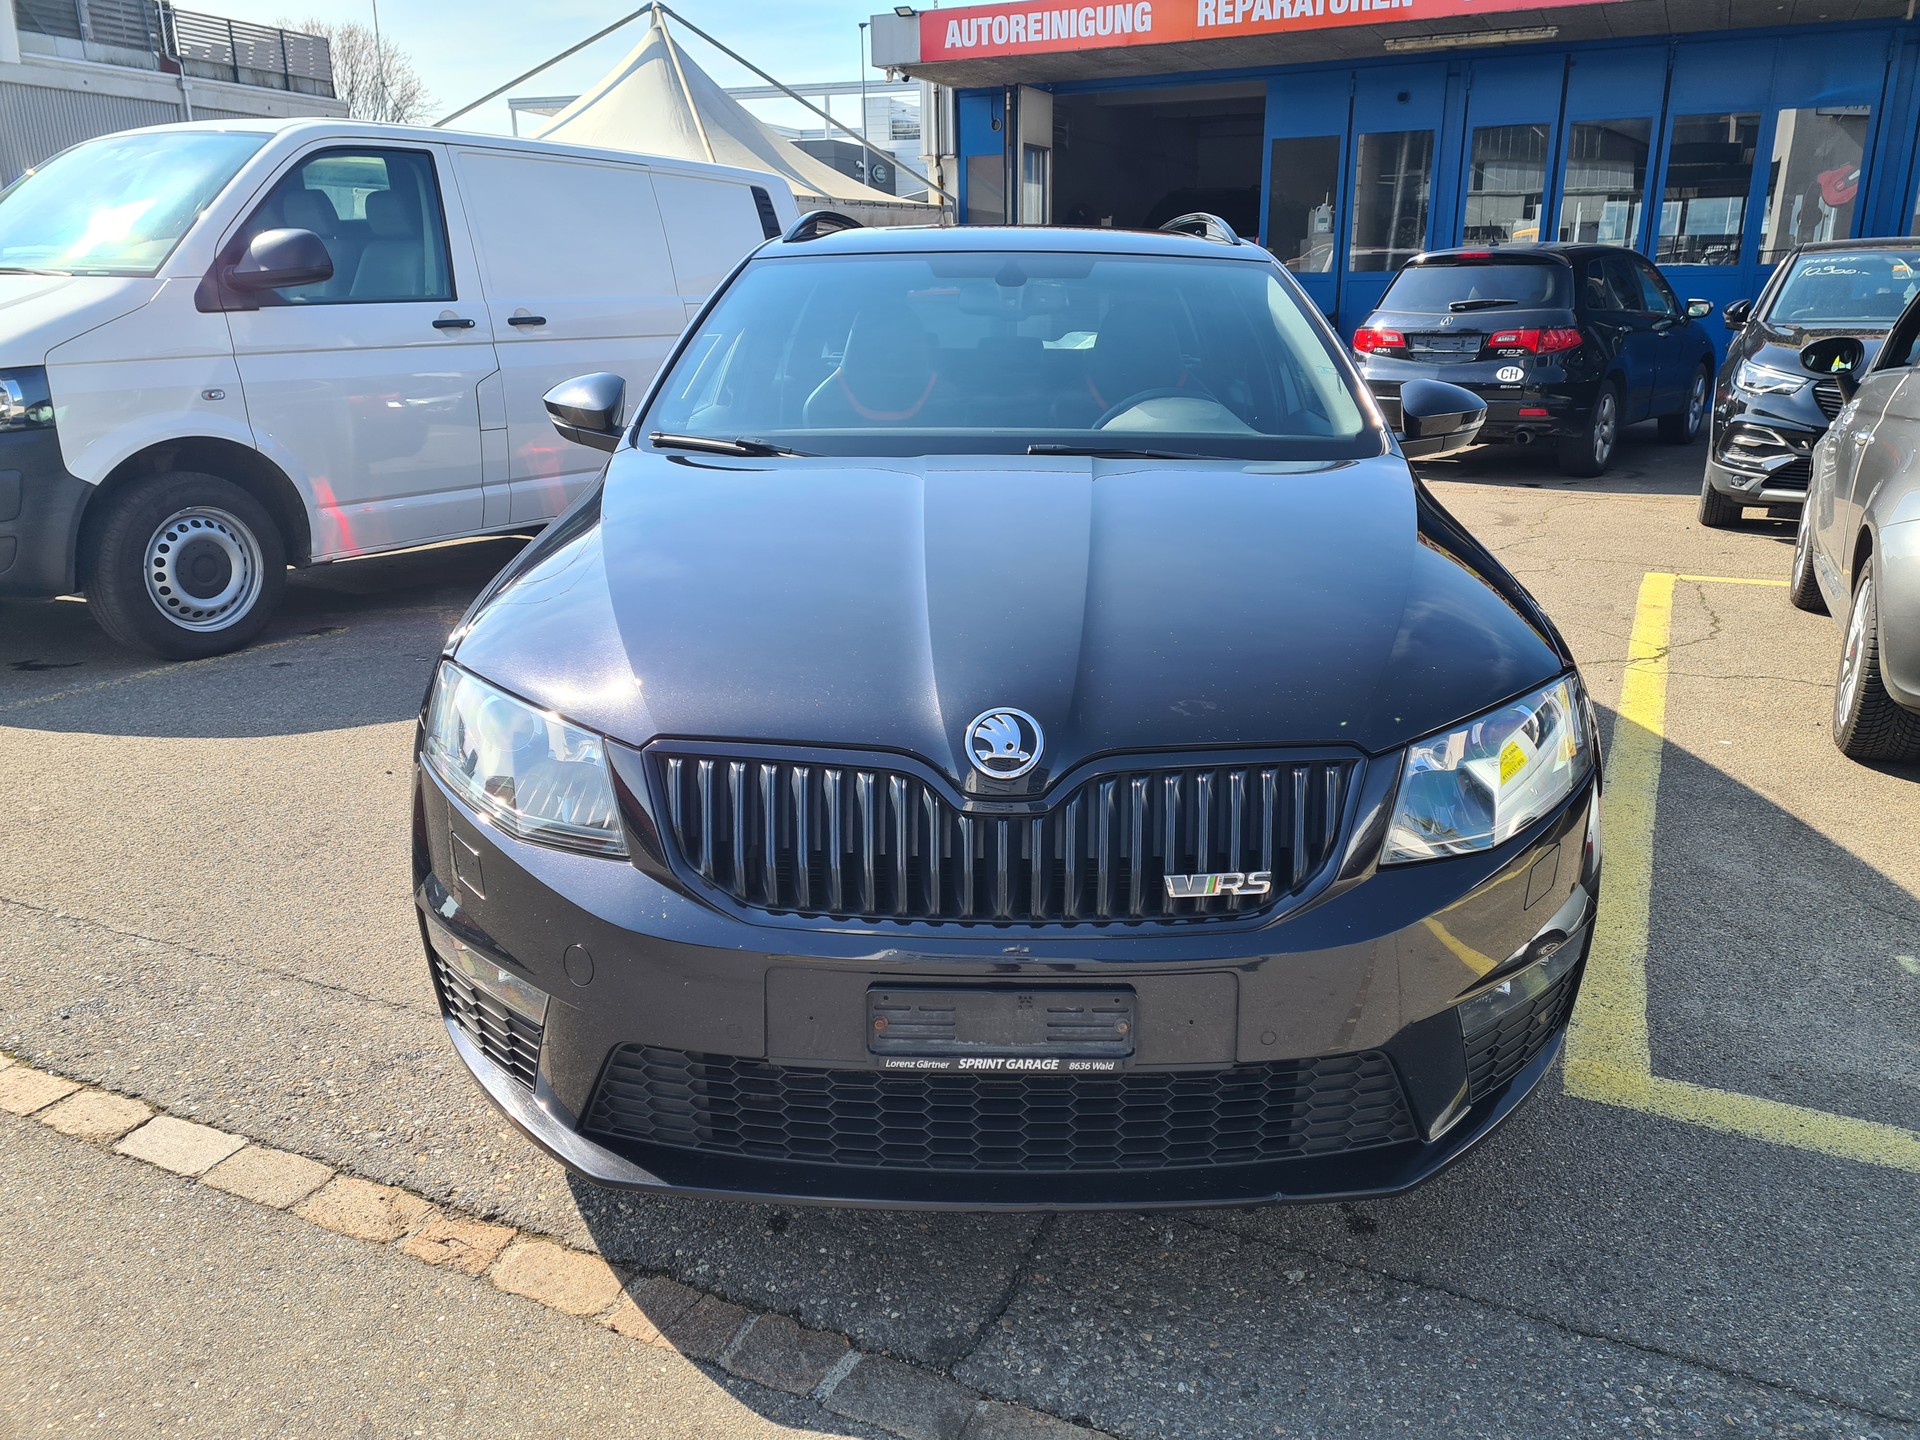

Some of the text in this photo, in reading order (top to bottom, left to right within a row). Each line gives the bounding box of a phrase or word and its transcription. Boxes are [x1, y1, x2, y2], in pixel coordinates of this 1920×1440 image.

[944, 0, 1413, 48] AUTOREINIGUNG REPARA
[1500, 368, 1519, 380] CH
[885, 1058, 1115, 1071] Lorenz Gärtner SPRINT GARAGE 8636 Wald
